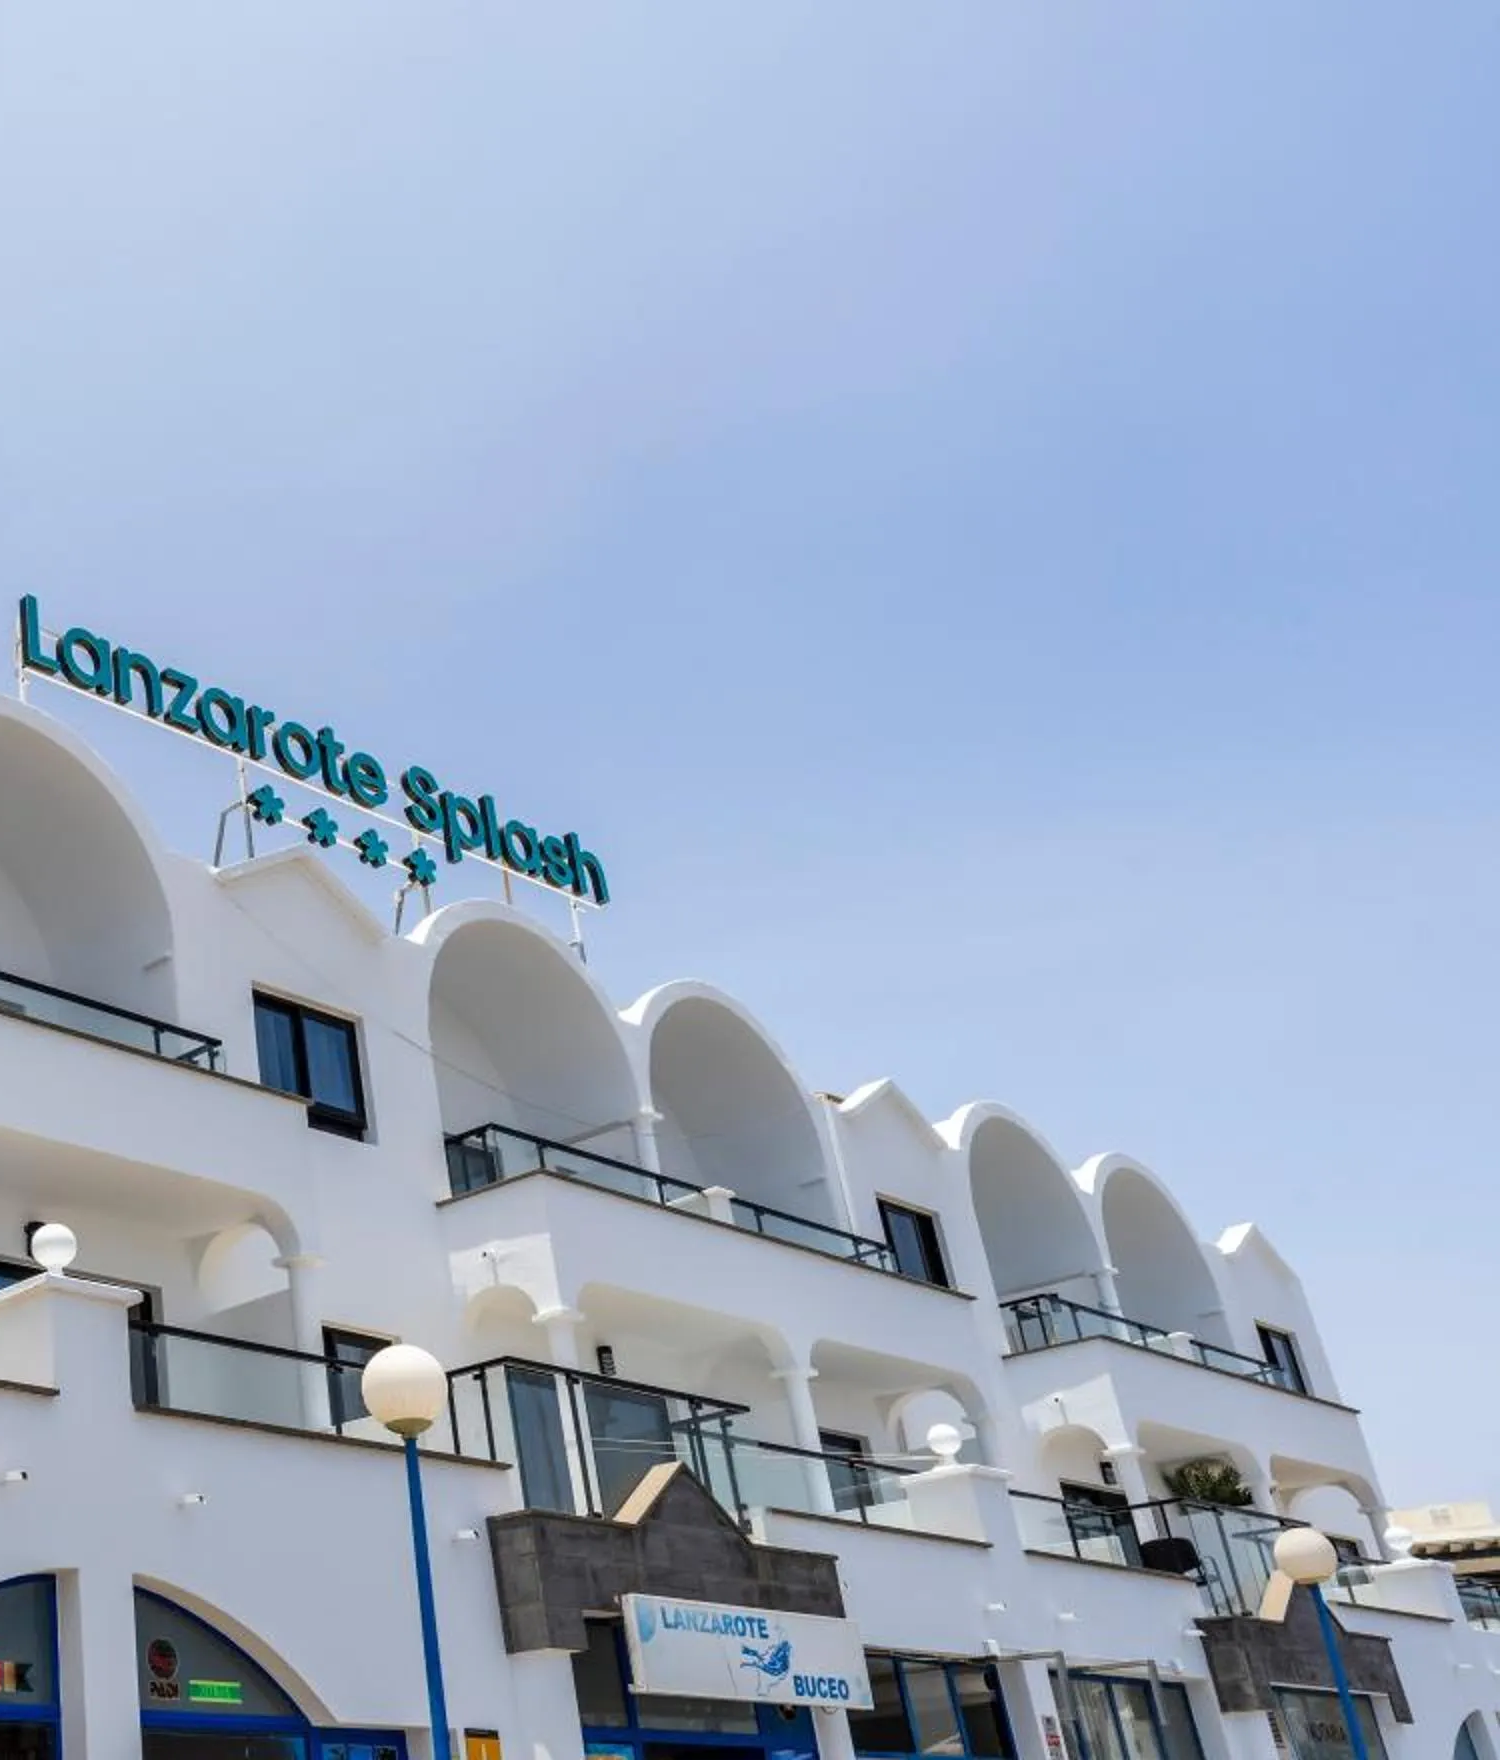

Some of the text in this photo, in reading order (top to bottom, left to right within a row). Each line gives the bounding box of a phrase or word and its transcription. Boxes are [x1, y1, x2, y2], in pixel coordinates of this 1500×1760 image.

[20, 593, 610, 907] Lanzarote Splash
[660, 1606, 770, 1639] LANZAROTE
[793, 1675, 849, 1700] BUCEO
